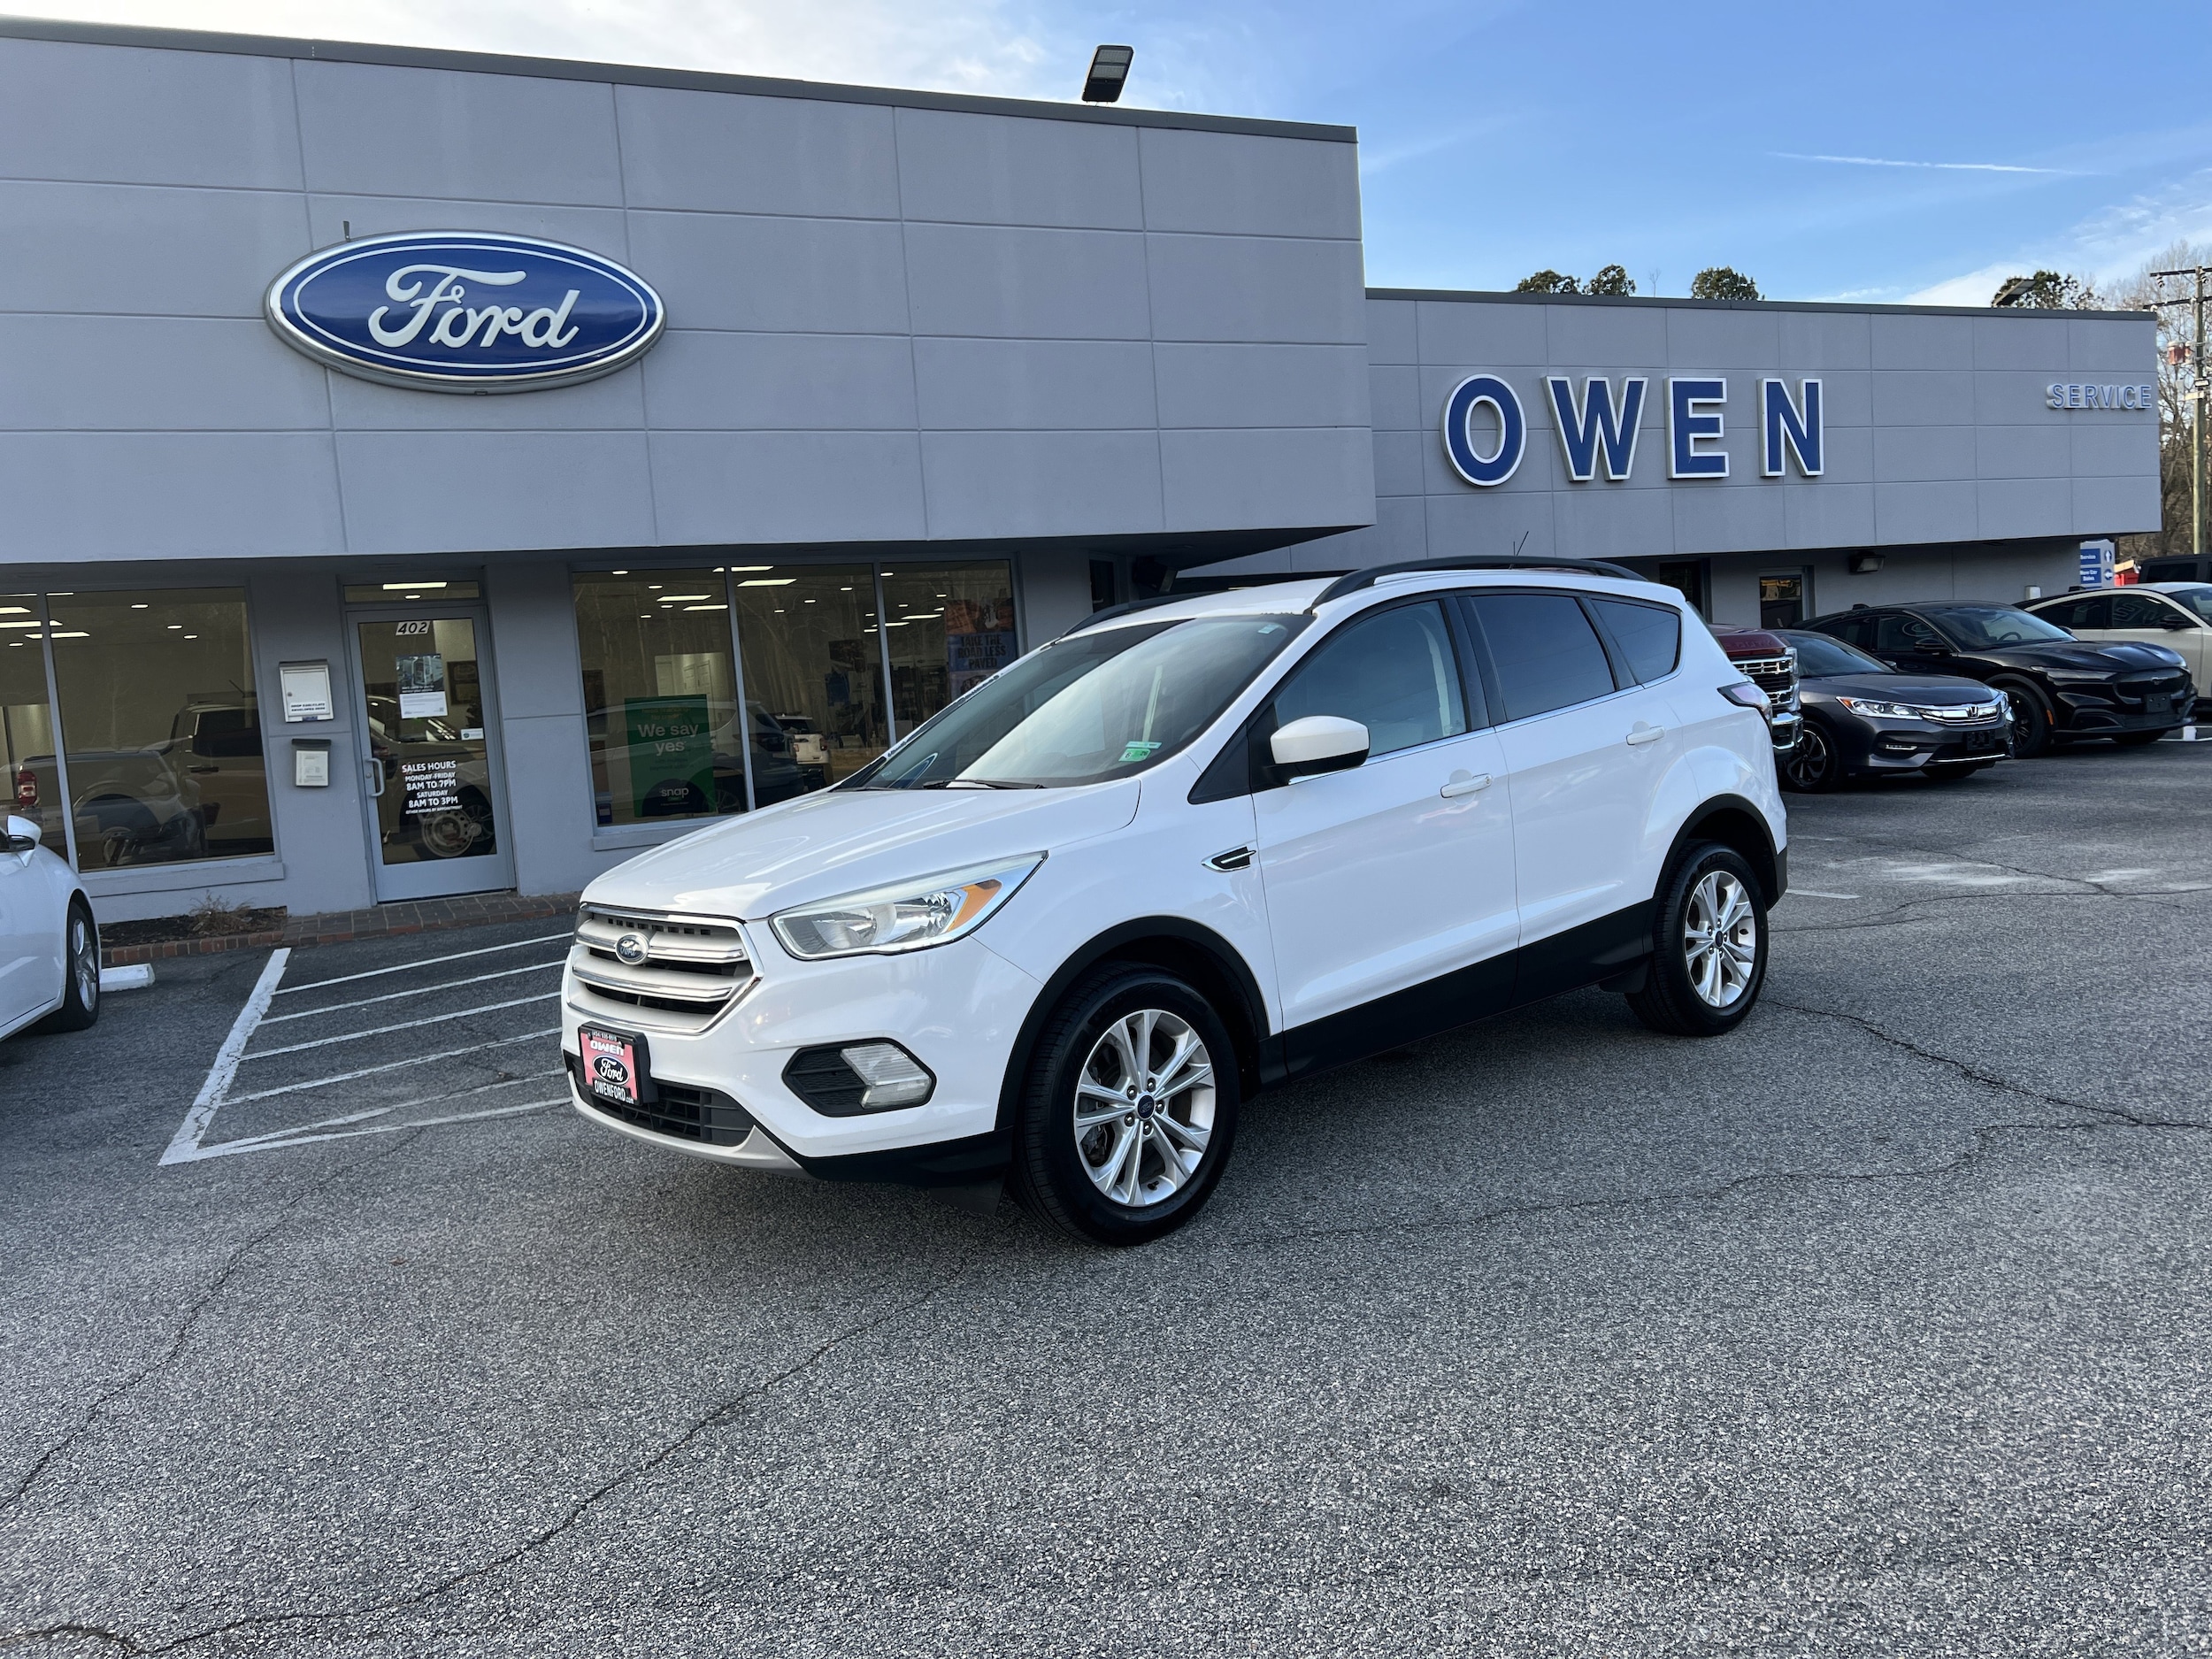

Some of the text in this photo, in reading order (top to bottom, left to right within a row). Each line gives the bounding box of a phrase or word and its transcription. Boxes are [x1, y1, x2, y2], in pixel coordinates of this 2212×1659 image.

[368, 264, 580, 348] Ford
[2048, 383, 2152, 409] SERVICE
[1440, 373, 1824, 487] OWEN
[397, 622, 427, 634] 402
[961, 634, 1002, 647] TAKE THE
[957, 645, 1006, 659] ROAD LESS
[968, 657, 998, 670] PAVED
[637, 724, 699, 737] We say
[655, 741, 685, 757] yes
[402, 760, 457, 773] SALES HOURS
[404, 772, 456, 782] MONDAY-FRIDAY
[406, 779, 457, 791] 8AM TO 7PM
[417, 789, 449, 798] SATURDAY
[661, 787, 689, 798] snap
[408, 795, 458, 808] 8AM TO 3PM
[590, 1040, 625, 1056] OWEN
[600, 1058, 623, 1081] Ford
[594, 1080, 634, 1104] OWENFORD.com
